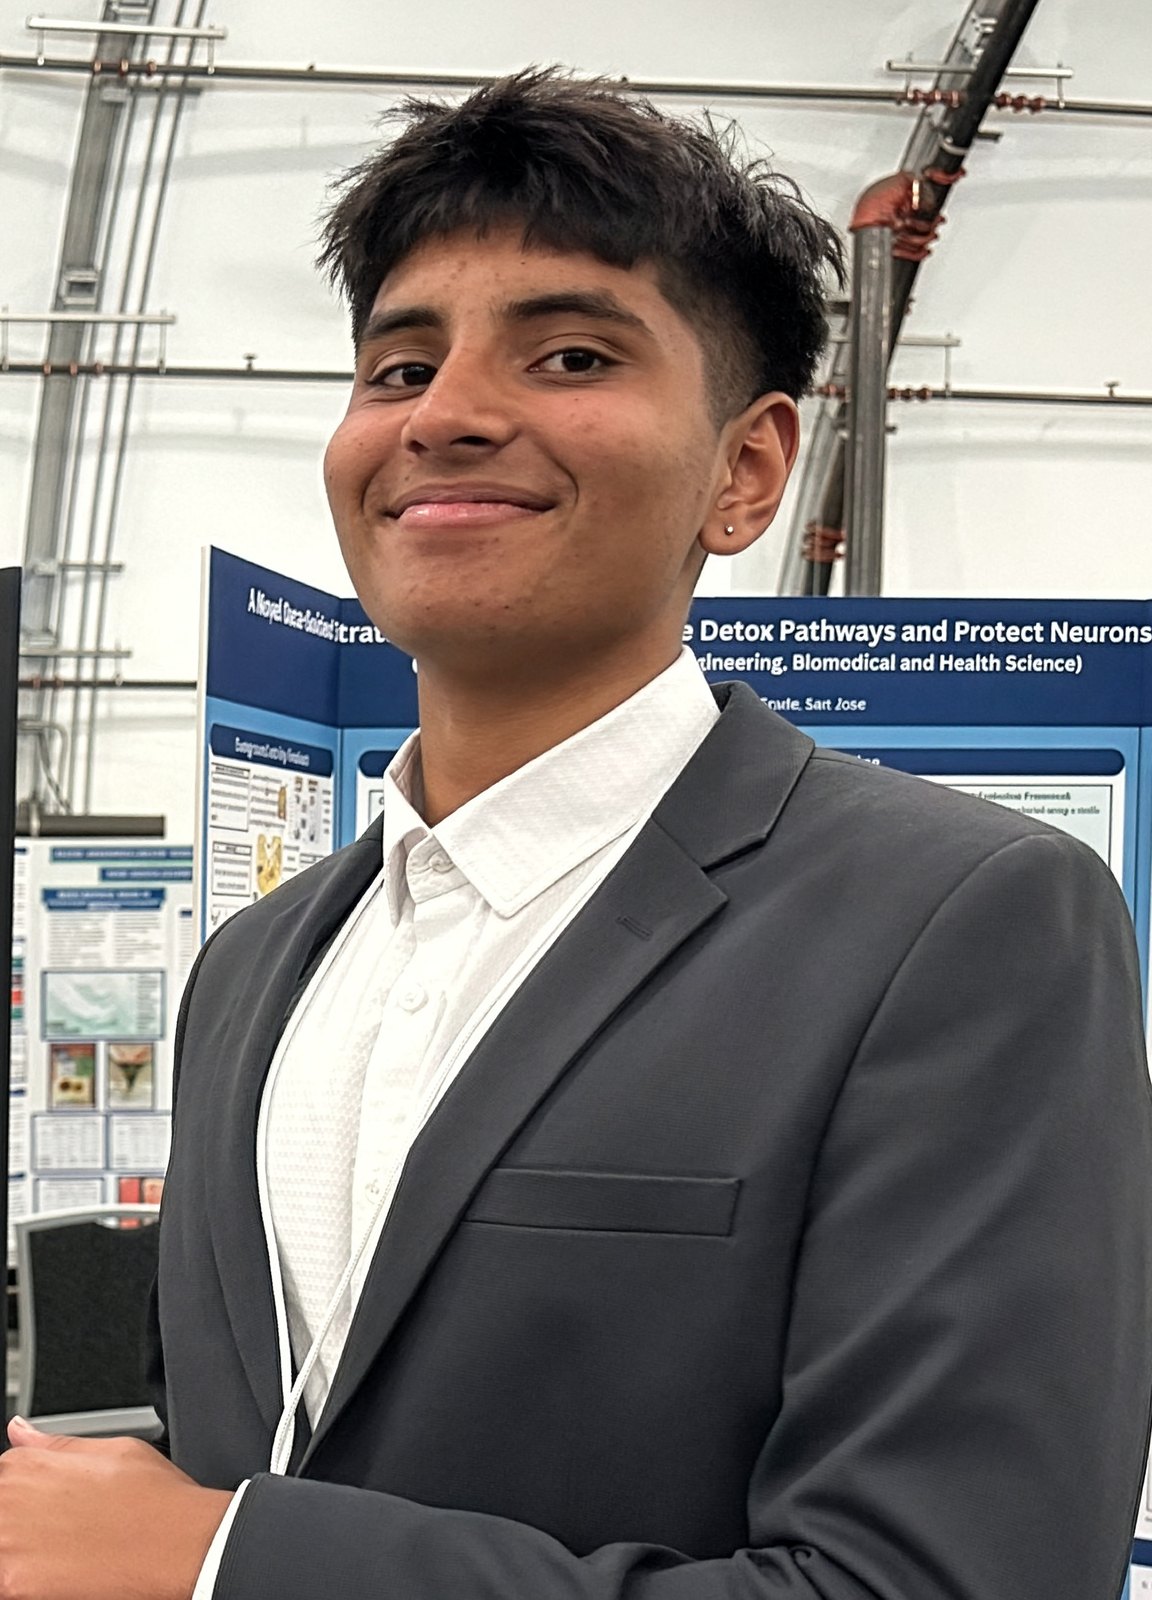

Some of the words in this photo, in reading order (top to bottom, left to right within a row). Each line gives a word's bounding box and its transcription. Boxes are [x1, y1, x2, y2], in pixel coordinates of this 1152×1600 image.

[700, 619, 774, 642] Detox
[780, 618, 896, 648] Pathways
[901, 619, 948, 642] and
[954, 621, 1044, 643] Protect
[1050, 621, 1152, 643] Neurons
[900, 653, 935, 672] and
[939, 653, 1001, 672] Health
[1005, 654, 1083, 675] Science)
